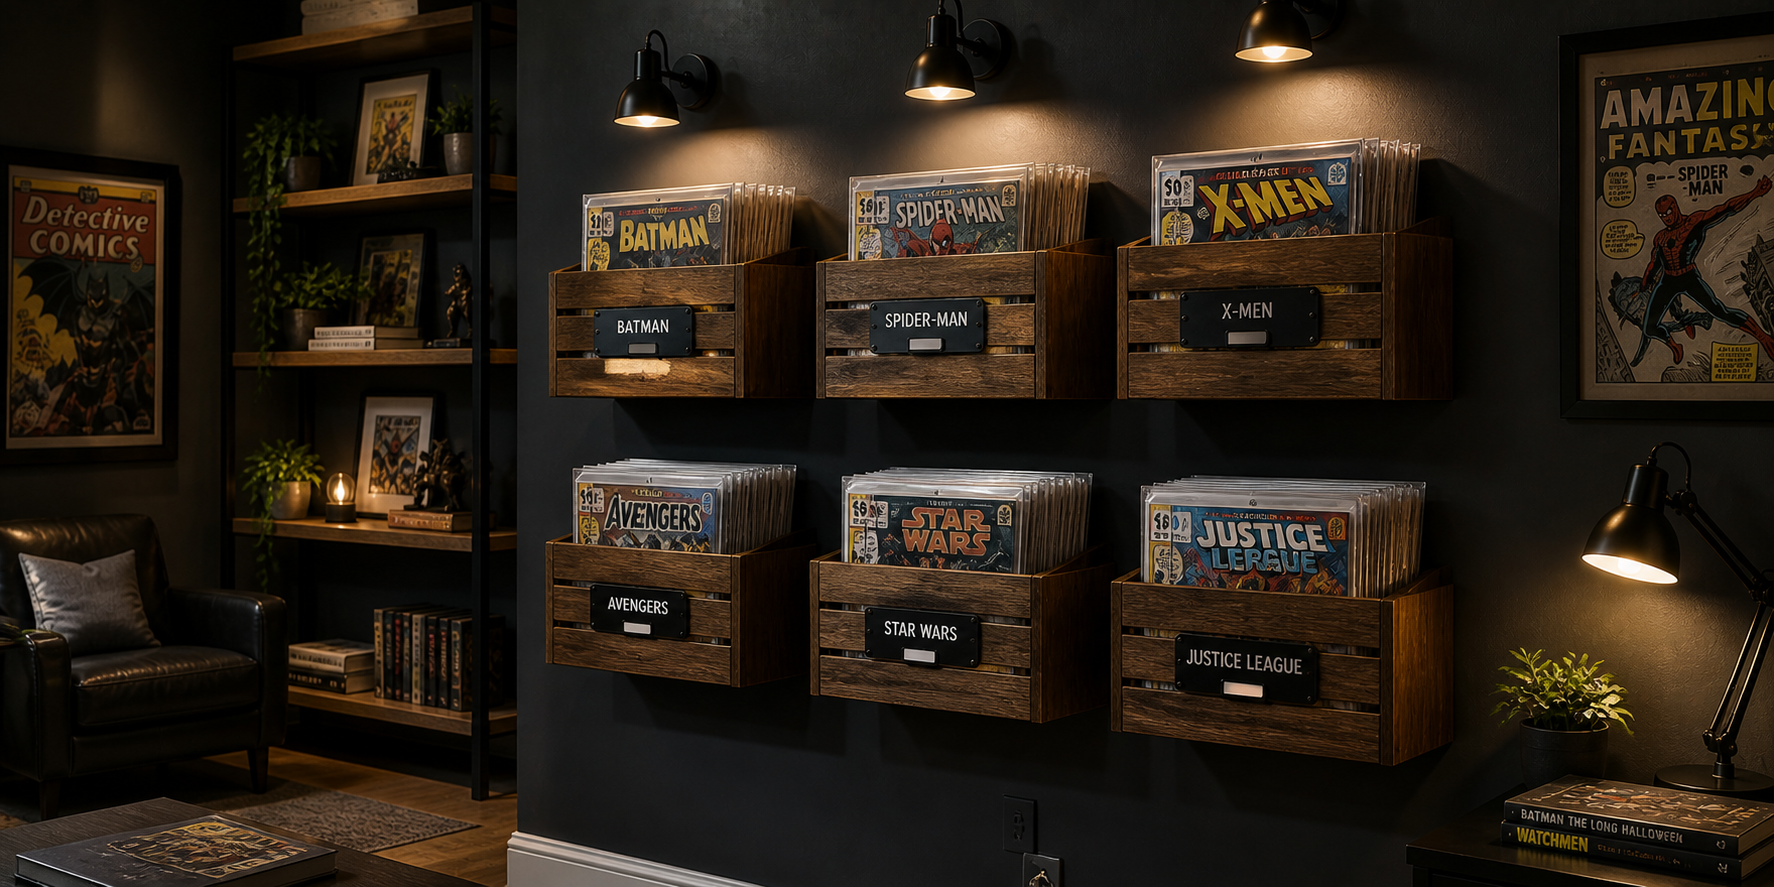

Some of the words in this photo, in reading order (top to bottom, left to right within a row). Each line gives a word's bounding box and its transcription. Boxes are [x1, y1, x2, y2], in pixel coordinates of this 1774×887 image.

[1678, 164, 1728, 182] SPIDER
[22, 194, 149, 233] Detective
[895, 195, 1006, 228] SPIDER-MAN
[1197, 176, 1334, 238] X-MEN
[29, 229, 139, 261] COMICS
[619, 215, 710, 253] BATMAN
[885, 311, 968, 328] SPIDER-MAN
[1221, 302, 1273, 320] X-MEN
[617, 319, 669, 334] BATMAN
[604, 493, 702, 532] AVENGERS
[901, 507, 991, 532] STAR
[901, 529, 991, 556] WARS
[1196, 520, 1328, 552] JUSTICE
[607, 597, 669, 615] AVENGERS
[884, 621, 915, 637] STAR
[920, 623, 958, 641] WARS
[1186, 649, 1241, 670] JUSTICE
[1247, 655, 1303, 675] LEAGUE
[1520, 808, 1564, 825] BATMAN
[1568, 816, 1587, 829] THE
[1591, 819, 1618, 834] LONG
[1516, 826, 1589, 853] WATCHMEN
